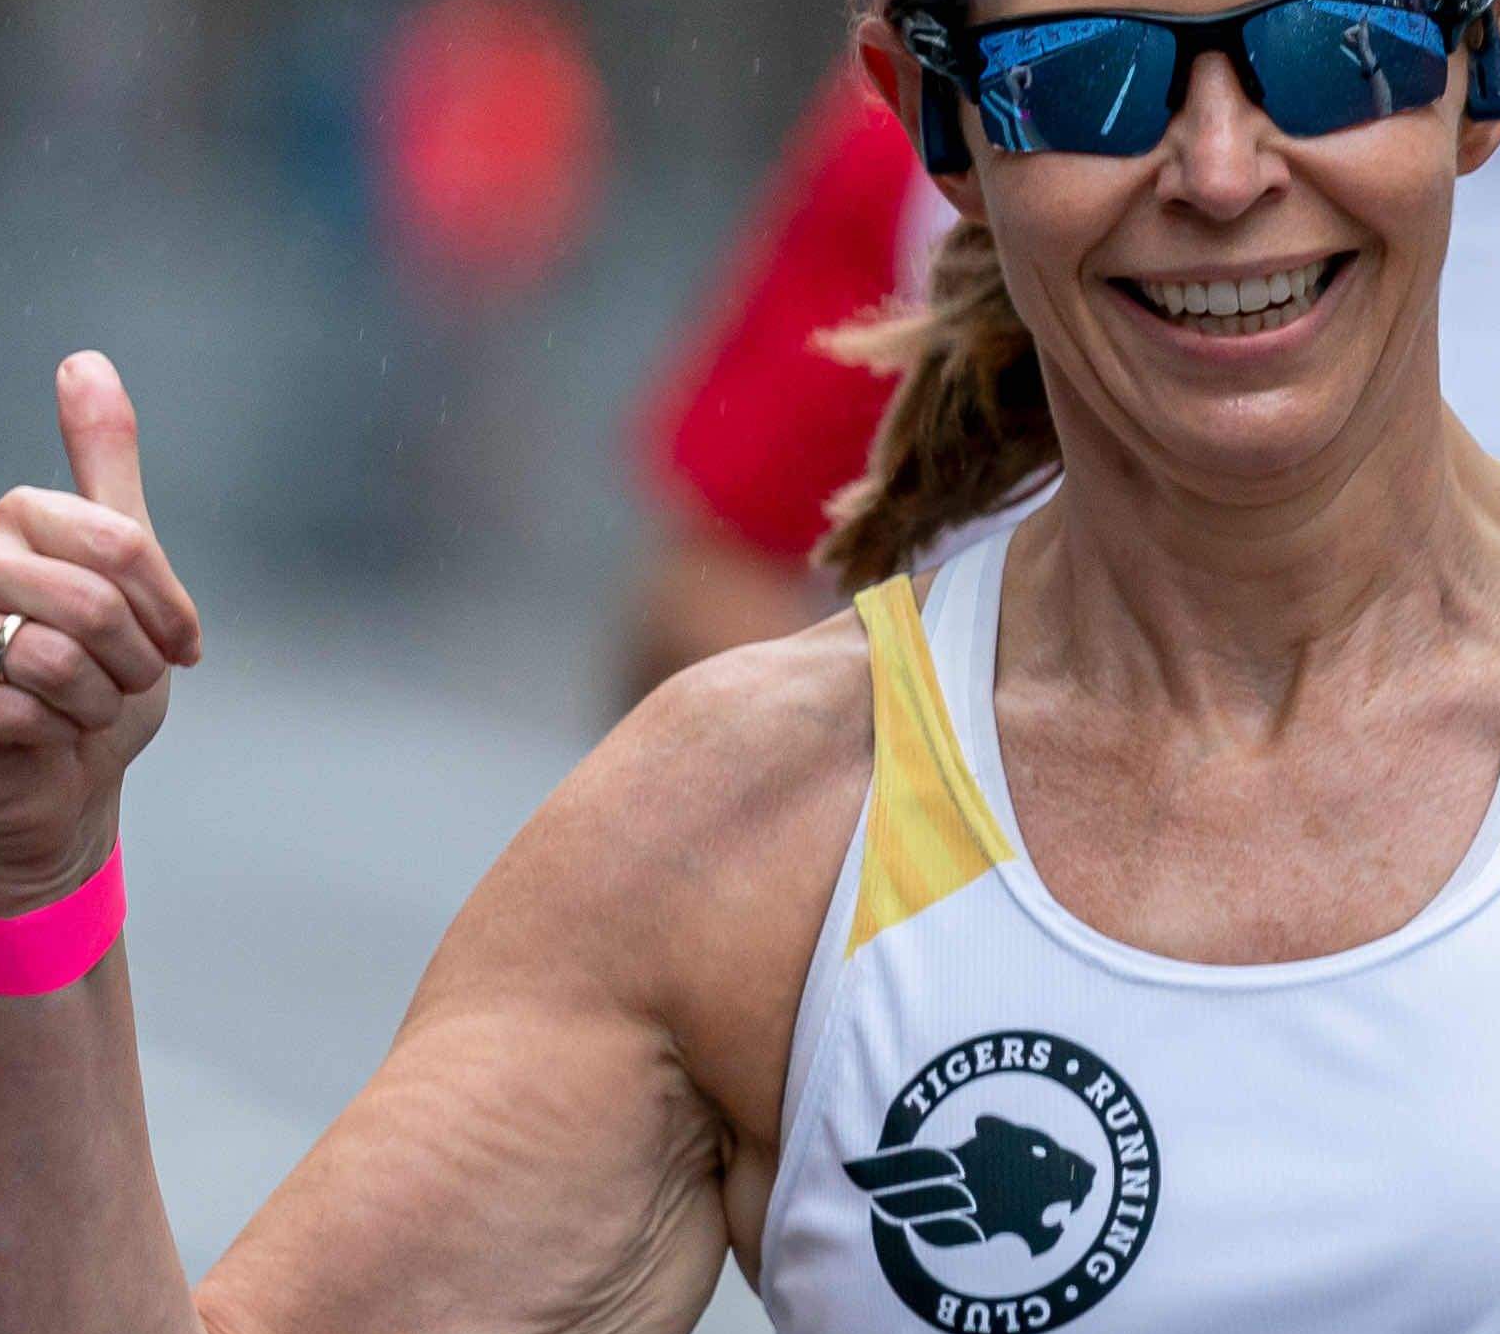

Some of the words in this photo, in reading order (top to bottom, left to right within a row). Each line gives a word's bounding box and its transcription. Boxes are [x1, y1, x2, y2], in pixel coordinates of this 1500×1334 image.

[904, 1037, 1052, 1115] TIGERS
[1085, 1071, 1151, 1283] RUNNING
[937, 1293, 1051, 1334] CLUB
